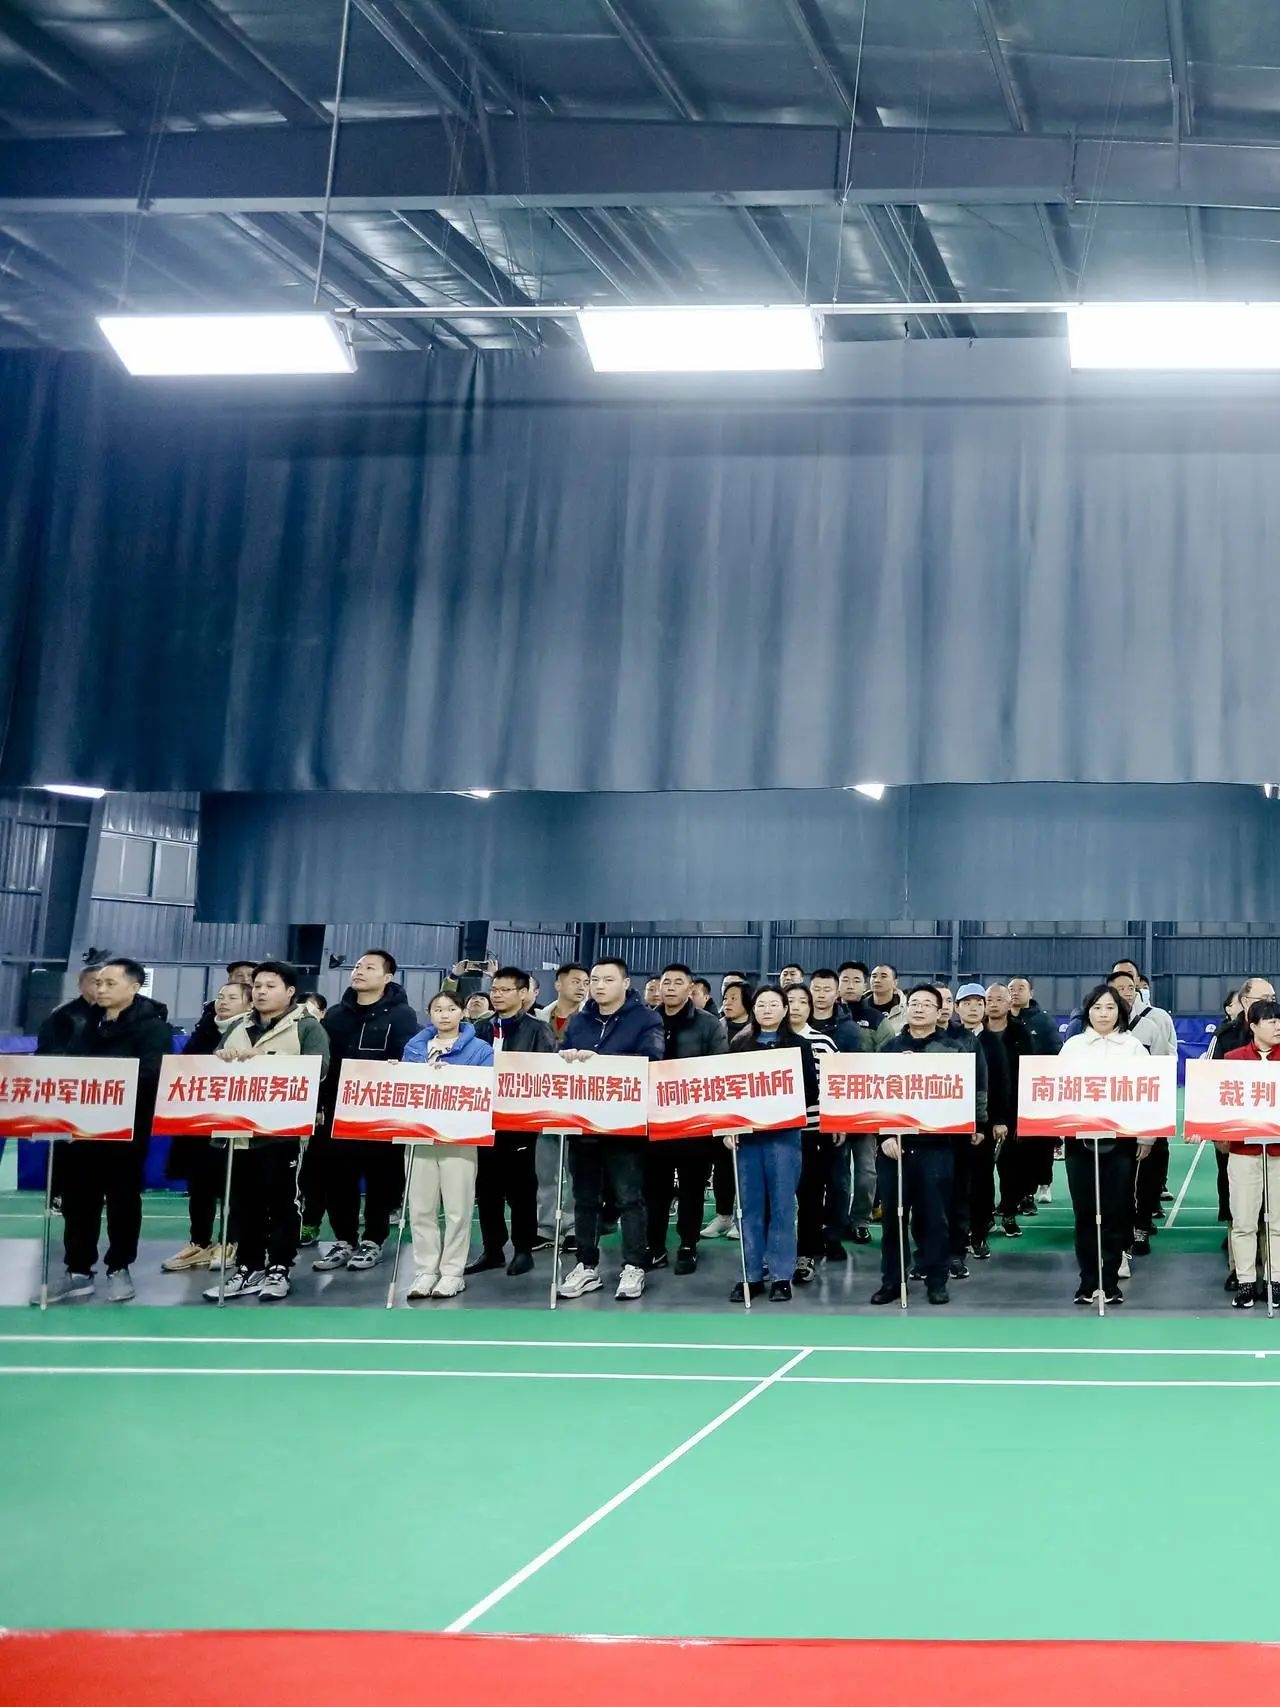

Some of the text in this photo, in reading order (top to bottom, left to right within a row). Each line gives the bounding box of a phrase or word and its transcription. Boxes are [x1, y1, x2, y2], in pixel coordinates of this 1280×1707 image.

[167, 1075, 310, 1103] 大托军休服务站
[342, 1079, 492, 1112] 科大佳园军休服务站
[497, 1072, 642, 1103] 观沙岭军休服务站
[656, 1068, 794, 1107] 桐梓坡军休所
[827, 1073, 964, 1100] 军用饮食供应站
[1031, 1075, 1161, 1102] 南湖军休所
